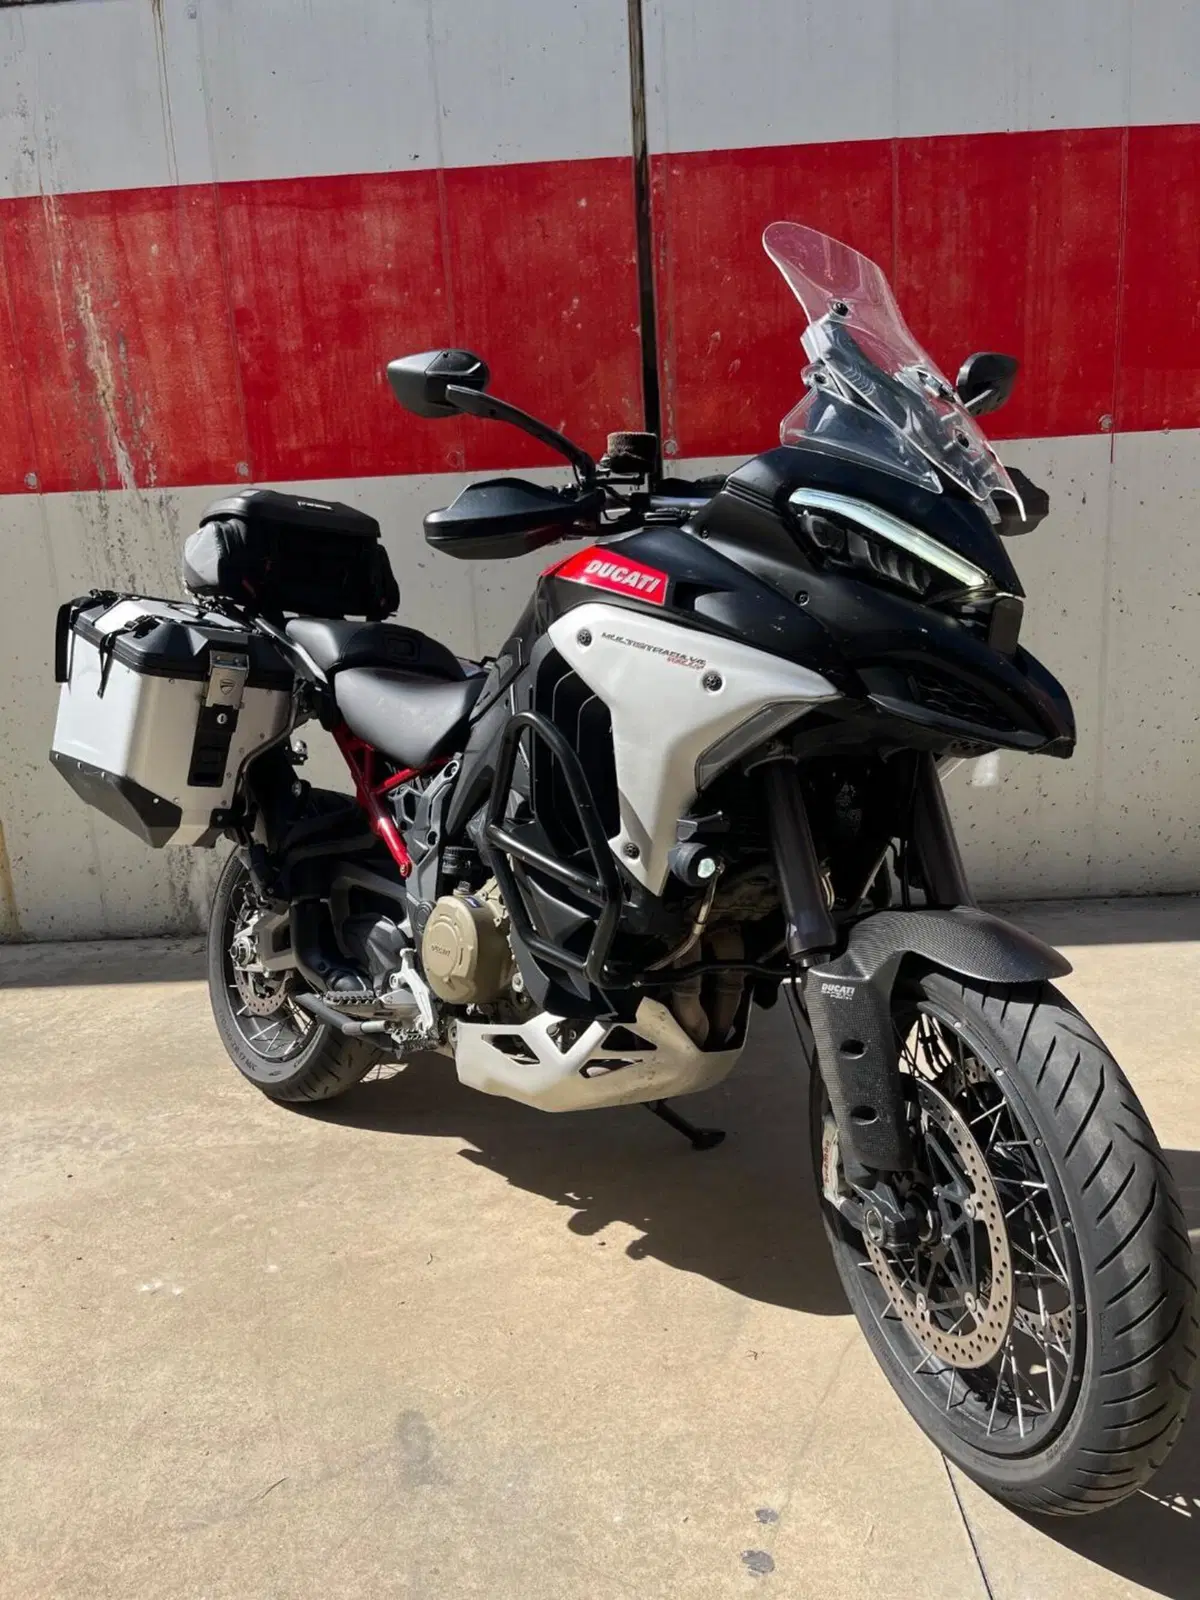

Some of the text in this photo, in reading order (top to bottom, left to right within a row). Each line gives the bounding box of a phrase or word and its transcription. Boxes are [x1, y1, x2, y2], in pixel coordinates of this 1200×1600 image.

[584, 559, 661, 593] DUCATI
[601, 632, 687, 659] MULTISTRADA
[821, 983, 855, 996] DUCATI
